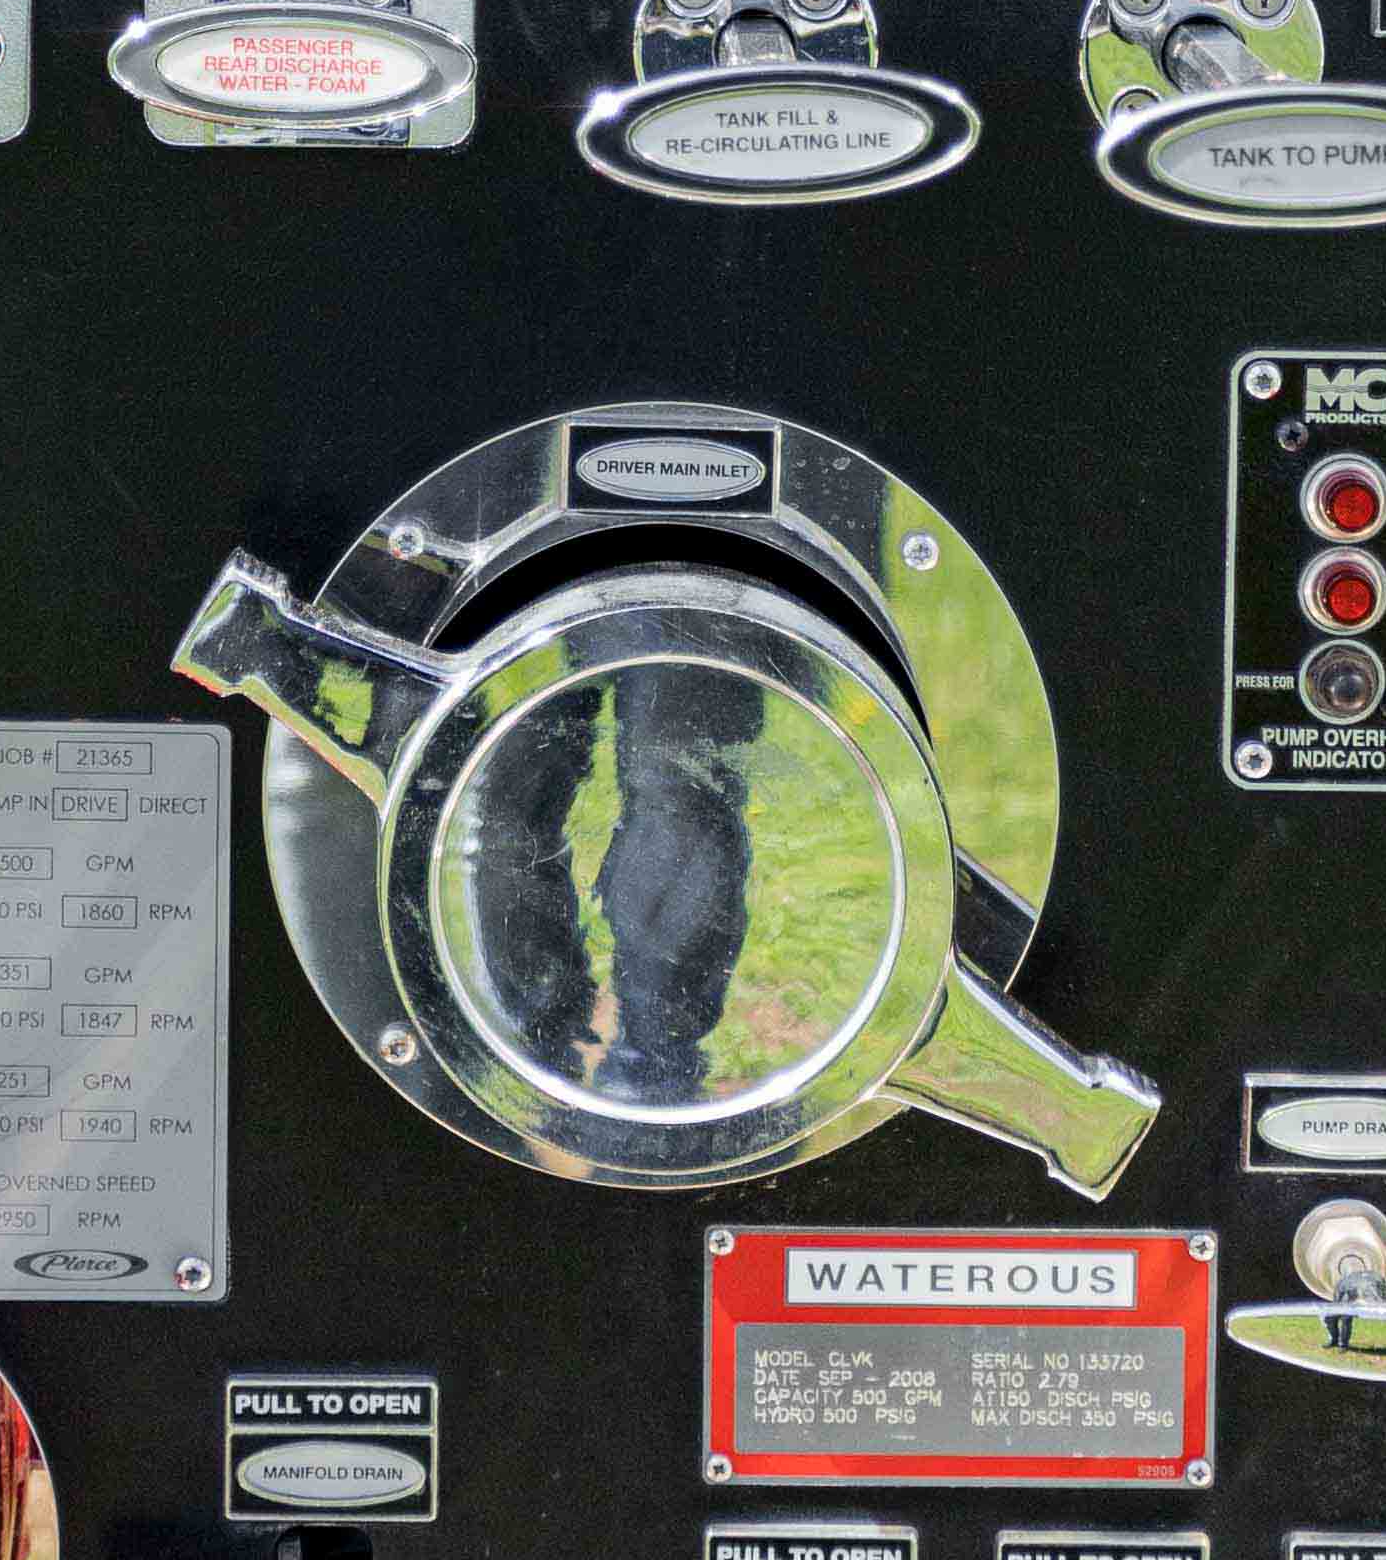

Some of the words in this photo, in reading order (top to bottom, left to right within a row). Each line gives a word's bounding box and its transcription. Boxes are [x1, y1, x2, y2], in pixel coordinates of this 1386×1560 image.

[233, 37, 353, 55] PASSENGER
[205, 56, 257, 72] REAR
[265, 57, 381, 75] DISCHARGE
[715, 112, 768, 128] TANK
[778, 111, 818, 125] FILL
[826, 110, 837, 124] &
[666, 134, 838, 154] RE-CIRCULATING
[847, 133, 889, 148] LINE
[1208, 148, 1273, 167] TANK
[1282, 146, 1314, 165] TO
[597, 460, 654, 474] DRIVER
[661, 463, 700, 475] MAIN
[705, 464, 751, 479] INLET
[1263, 729, 1318, 746] PUMP
[77, 749, 133, 768] 21365
[29, 792, 48, 811] IN
[62, 796, 117, 815] DRIVE
[140, 797, 207, 814] DIRECT
[0, 855, 33, 875] 500
[86, 855, 133, 872] GPM
[82, 904, 124, 920] 1860
[150, 904, 191, 920] RPM
[1303, 1121, 1348, 1133] PUMP
[807, 1263, 1114, 1293] WATEROUS
[236, 1394, 301, 1414] PULL
[307, 1394, 343, 1414] TO
[350, 1394, 420, 1414] OPEN
[264, 1466, 348, 1479] MANIFOLD
[354, 1467, 402, 1480] DRAIN
